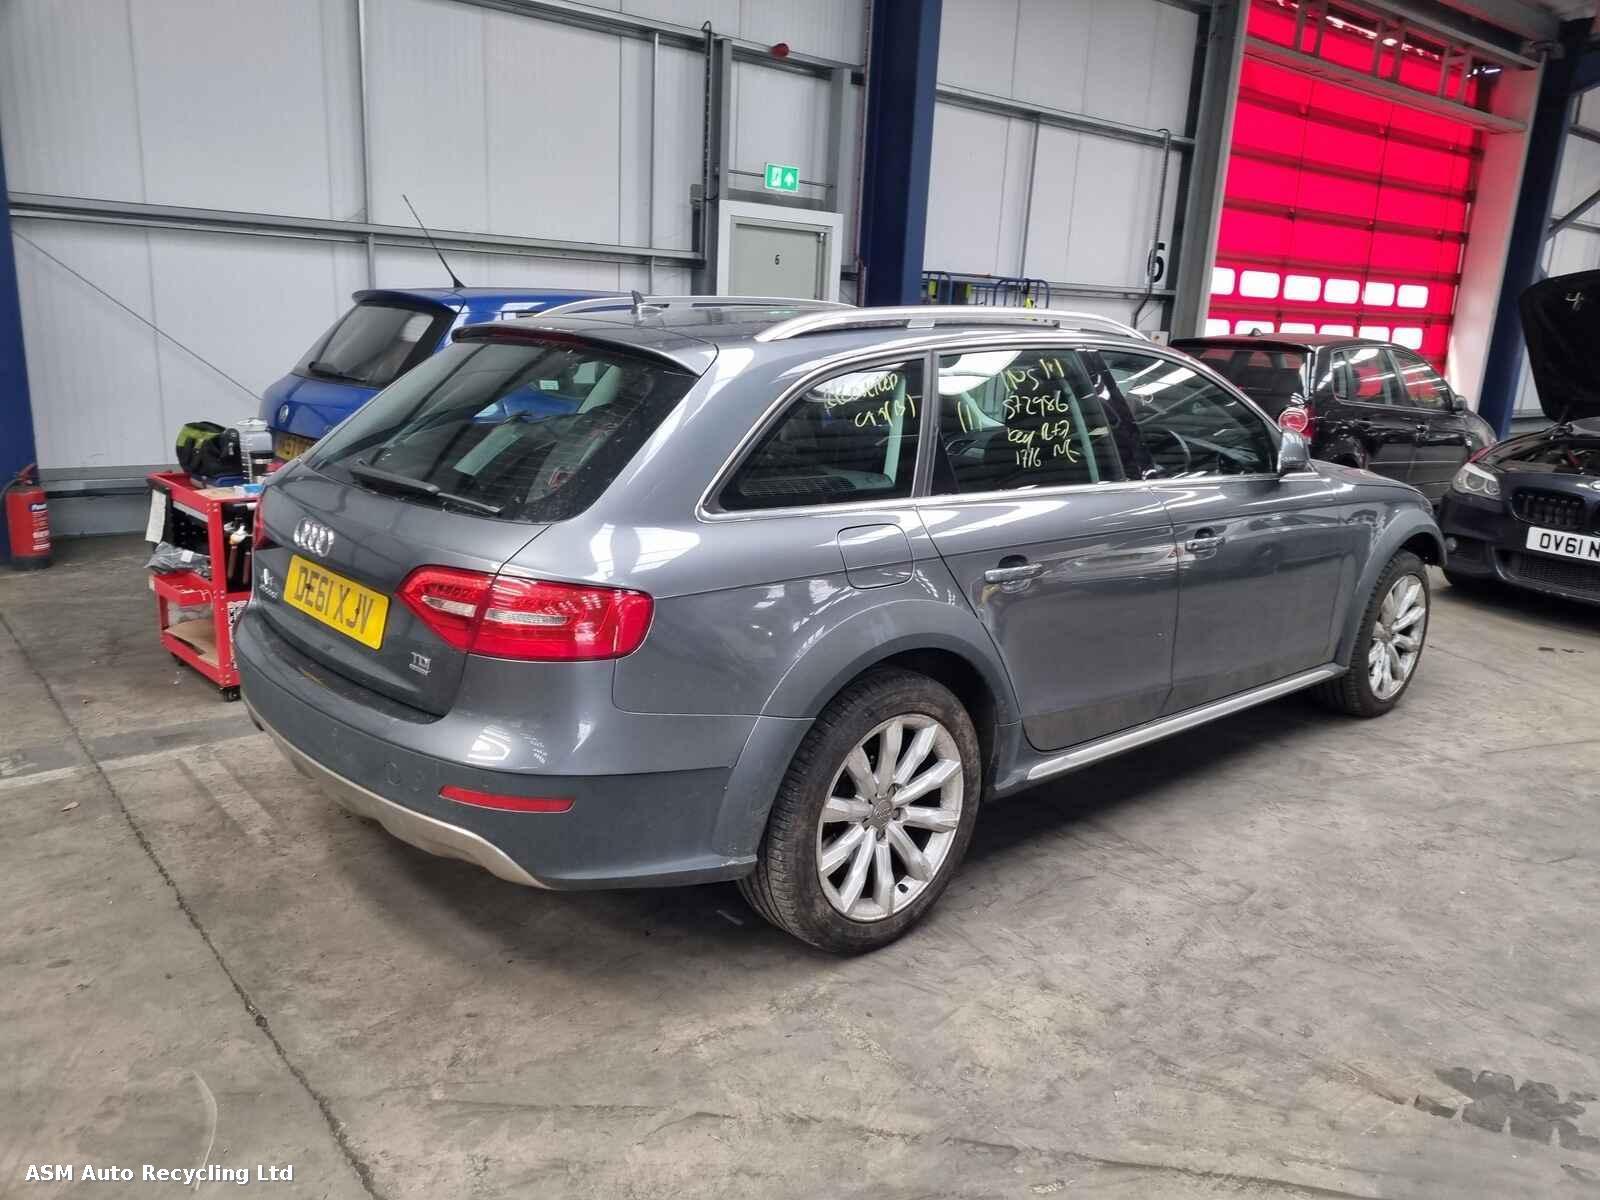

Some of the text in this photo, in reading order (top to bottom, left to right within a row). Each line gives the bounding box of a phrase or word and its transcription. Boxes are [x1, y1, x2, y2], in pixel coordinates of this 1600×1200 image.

[774, 253, 781, 266] 6
[1540, 533, 1583, 555] OV61
[295, 566, 374, 635] DE61 XJV
